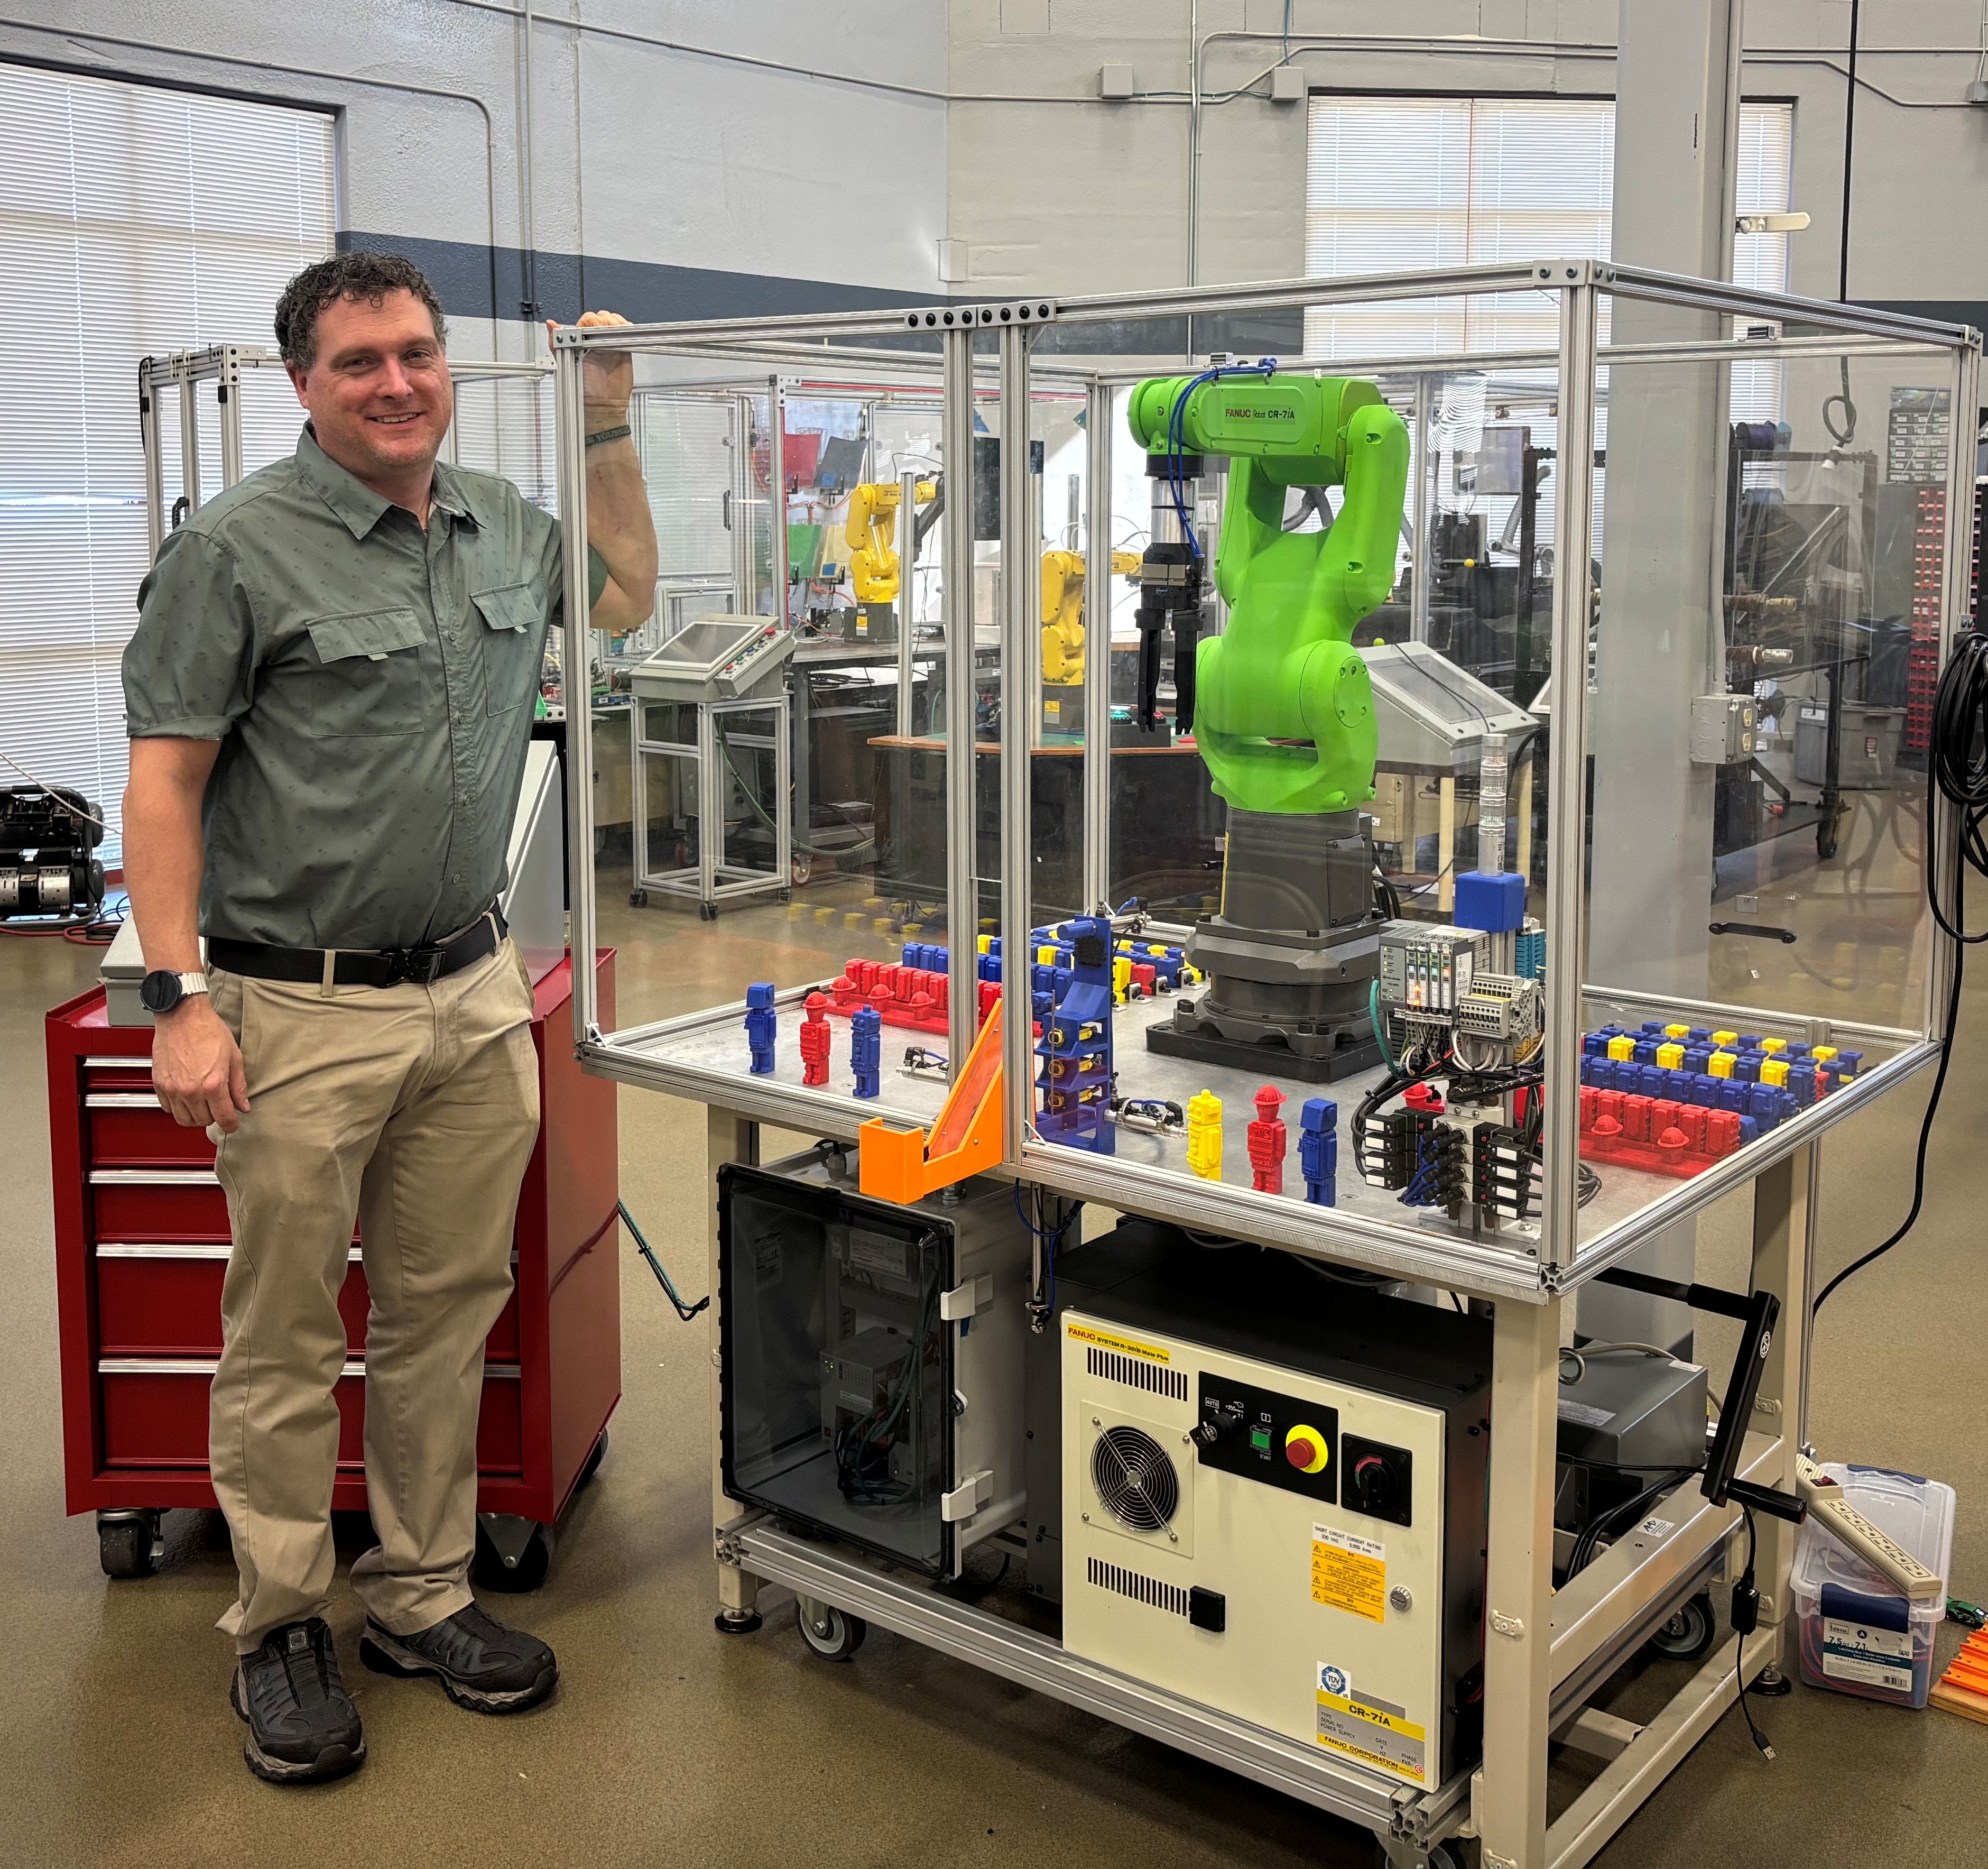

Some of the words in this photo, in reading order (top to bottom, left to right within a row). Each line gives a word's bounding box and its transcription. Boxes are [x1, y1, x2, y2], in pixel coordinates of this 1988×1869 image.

[1226, 409, 1251, 418] FANUC
[1253, 410, 1265, 418] Robot
[1268, 408, 1294, 419] CR-7iA
[1068, 1327, 1095, 1340] FANUC
[1097, 1337, 1120, 1347] SYSTEM
[1347, 1536, 1364, 1545] CURRENT
[1367, 1542, 1381, 1550] RATING
[1320, 1717, 1335, 1726] SERIAL
[1349, 1705, 1391, 1727] CR-7iA
[1320, 1722, 1336, 1733] POWER
[1338, 1728, 1355, 1738] SUPPLY
[1375, 1737, 1387, 1746] DATE
[1324, 1735, 1347, 1748] FANUC
[1349, 1745, 1398, 1769] CORPORATION
[1402, 1753, 1417, 1763] PHASE
